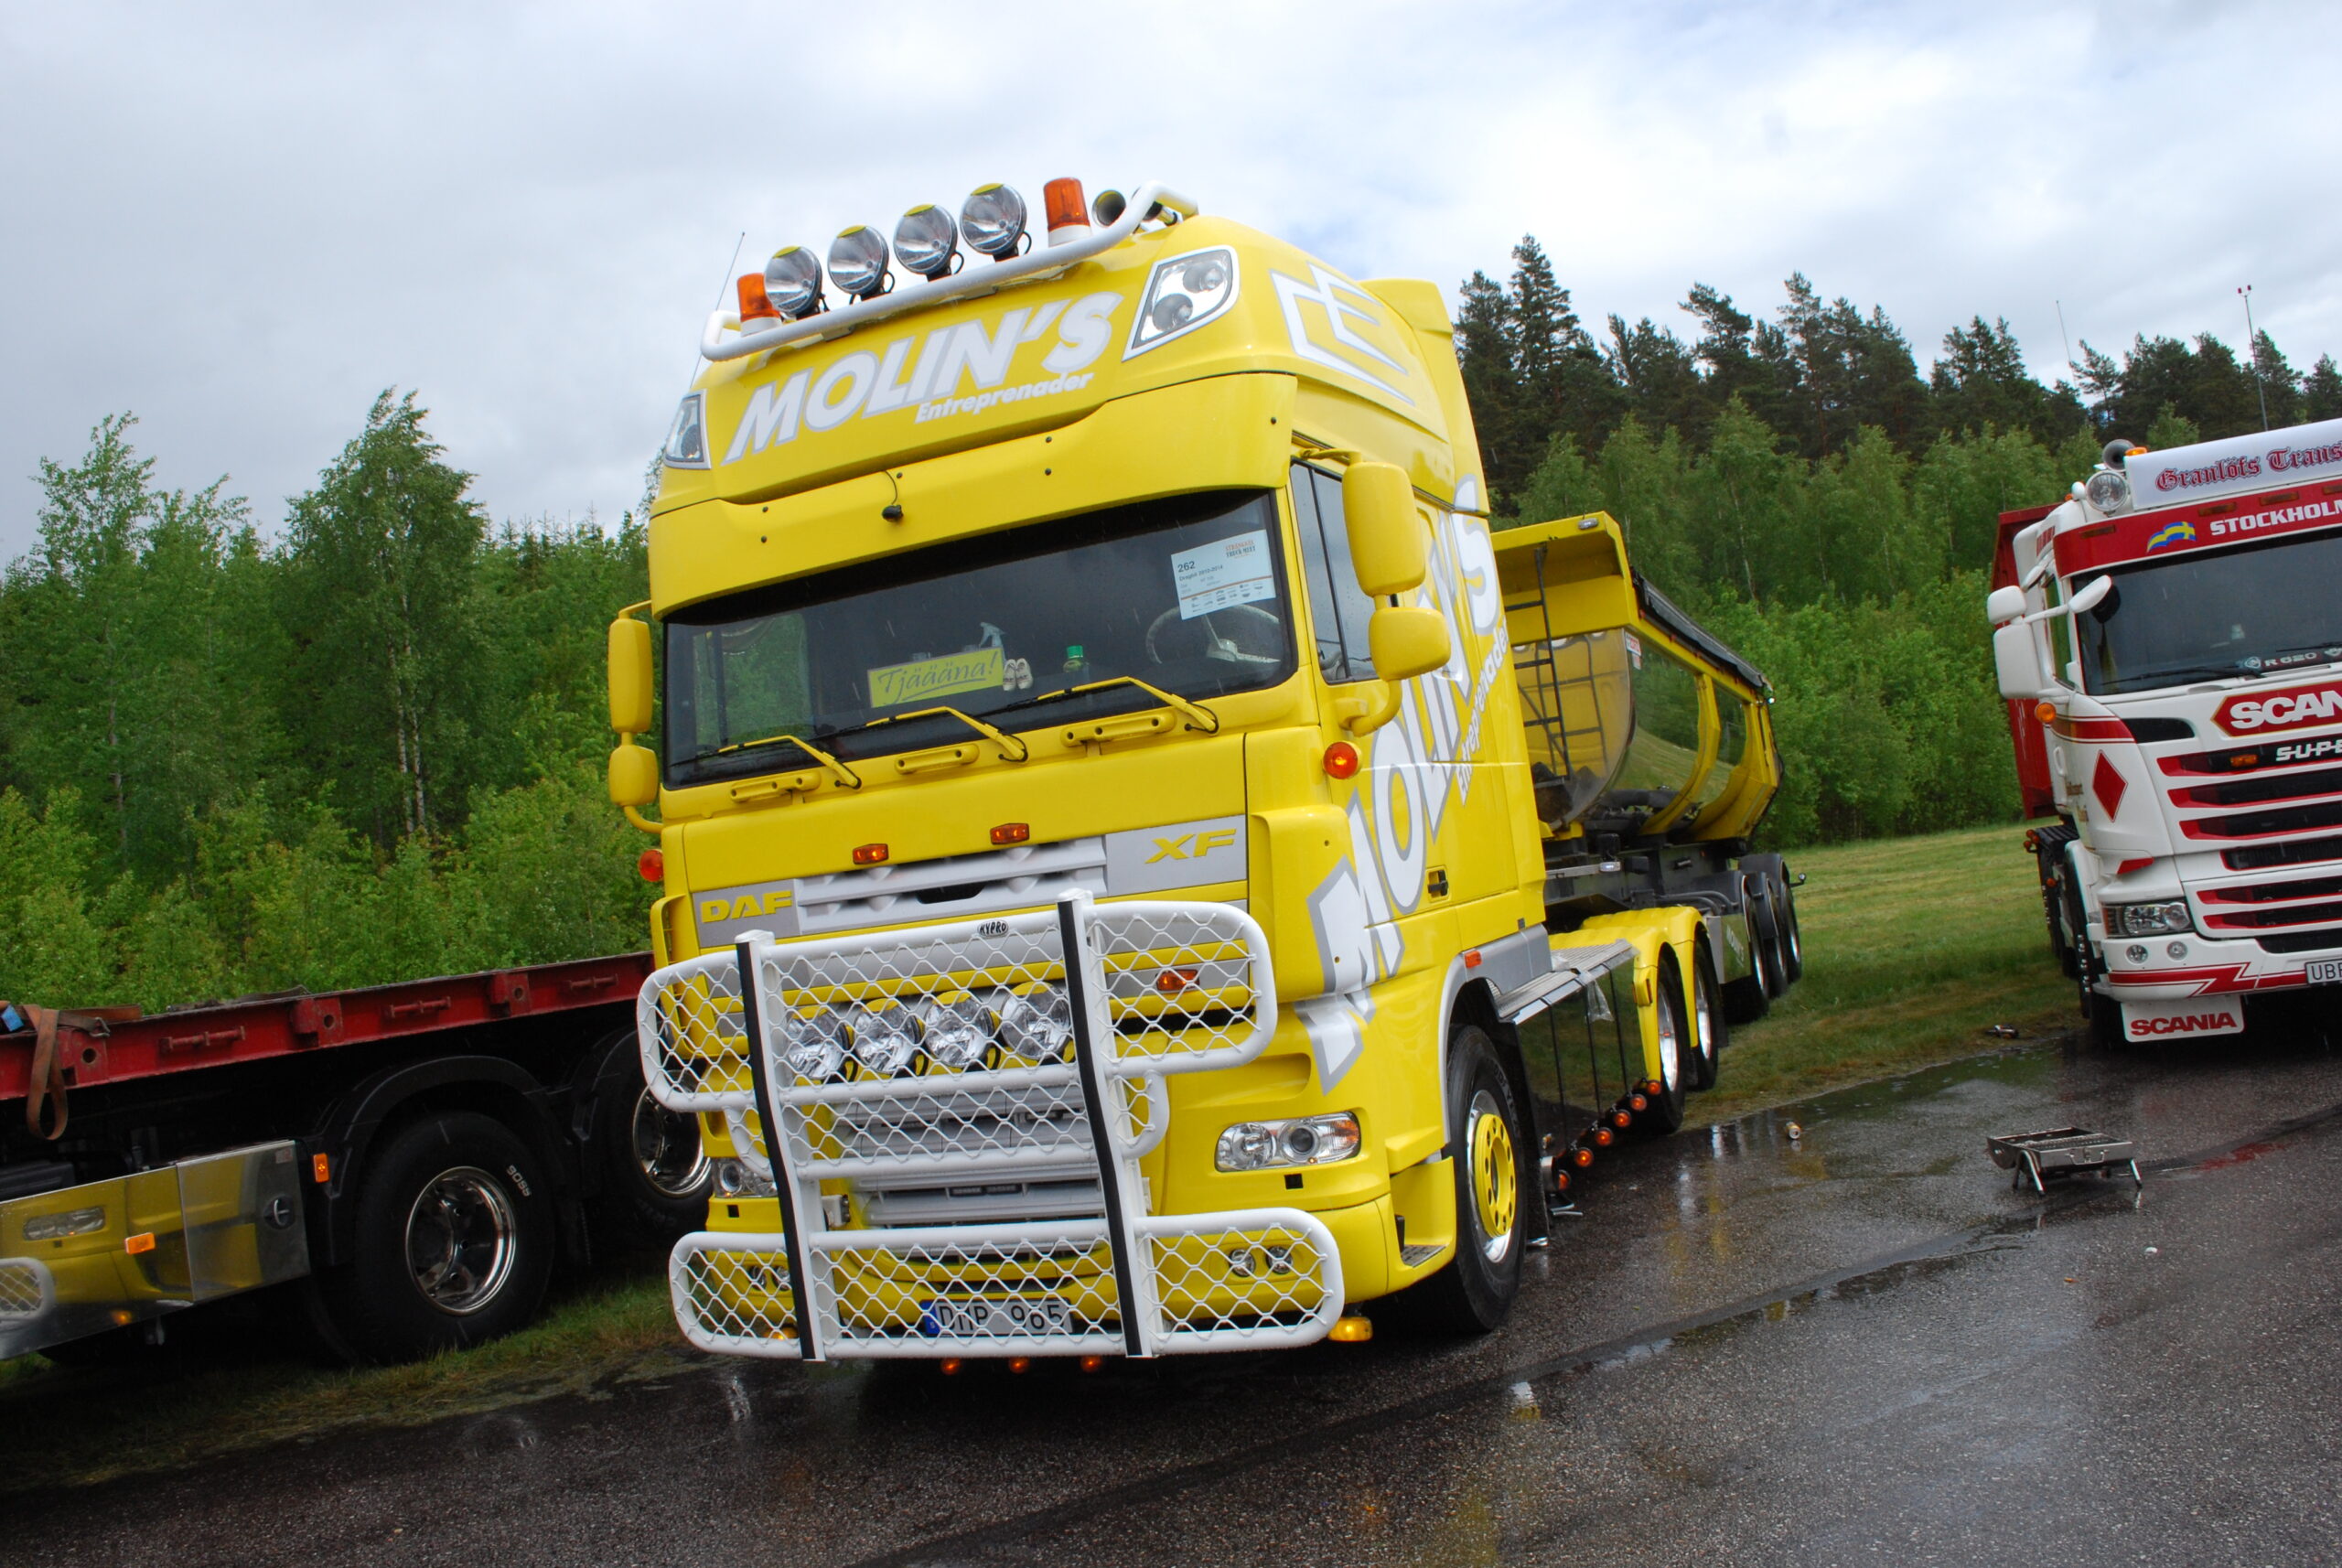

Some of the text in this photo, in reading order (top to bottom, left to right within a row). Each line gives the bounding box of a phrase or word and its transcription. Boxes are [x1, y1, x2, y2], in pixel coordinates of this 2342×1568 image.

[721, 291, 1124, 466] MOLIN'S
[916, 371, 1094, 424] Entreprenader
[1177, 561, 1195, 573] 262
[1145, 829, 1237, 864] XF
[701, 890, 793, 923] DAF
[2131, 1012, 2238, 1036] SCANIA
